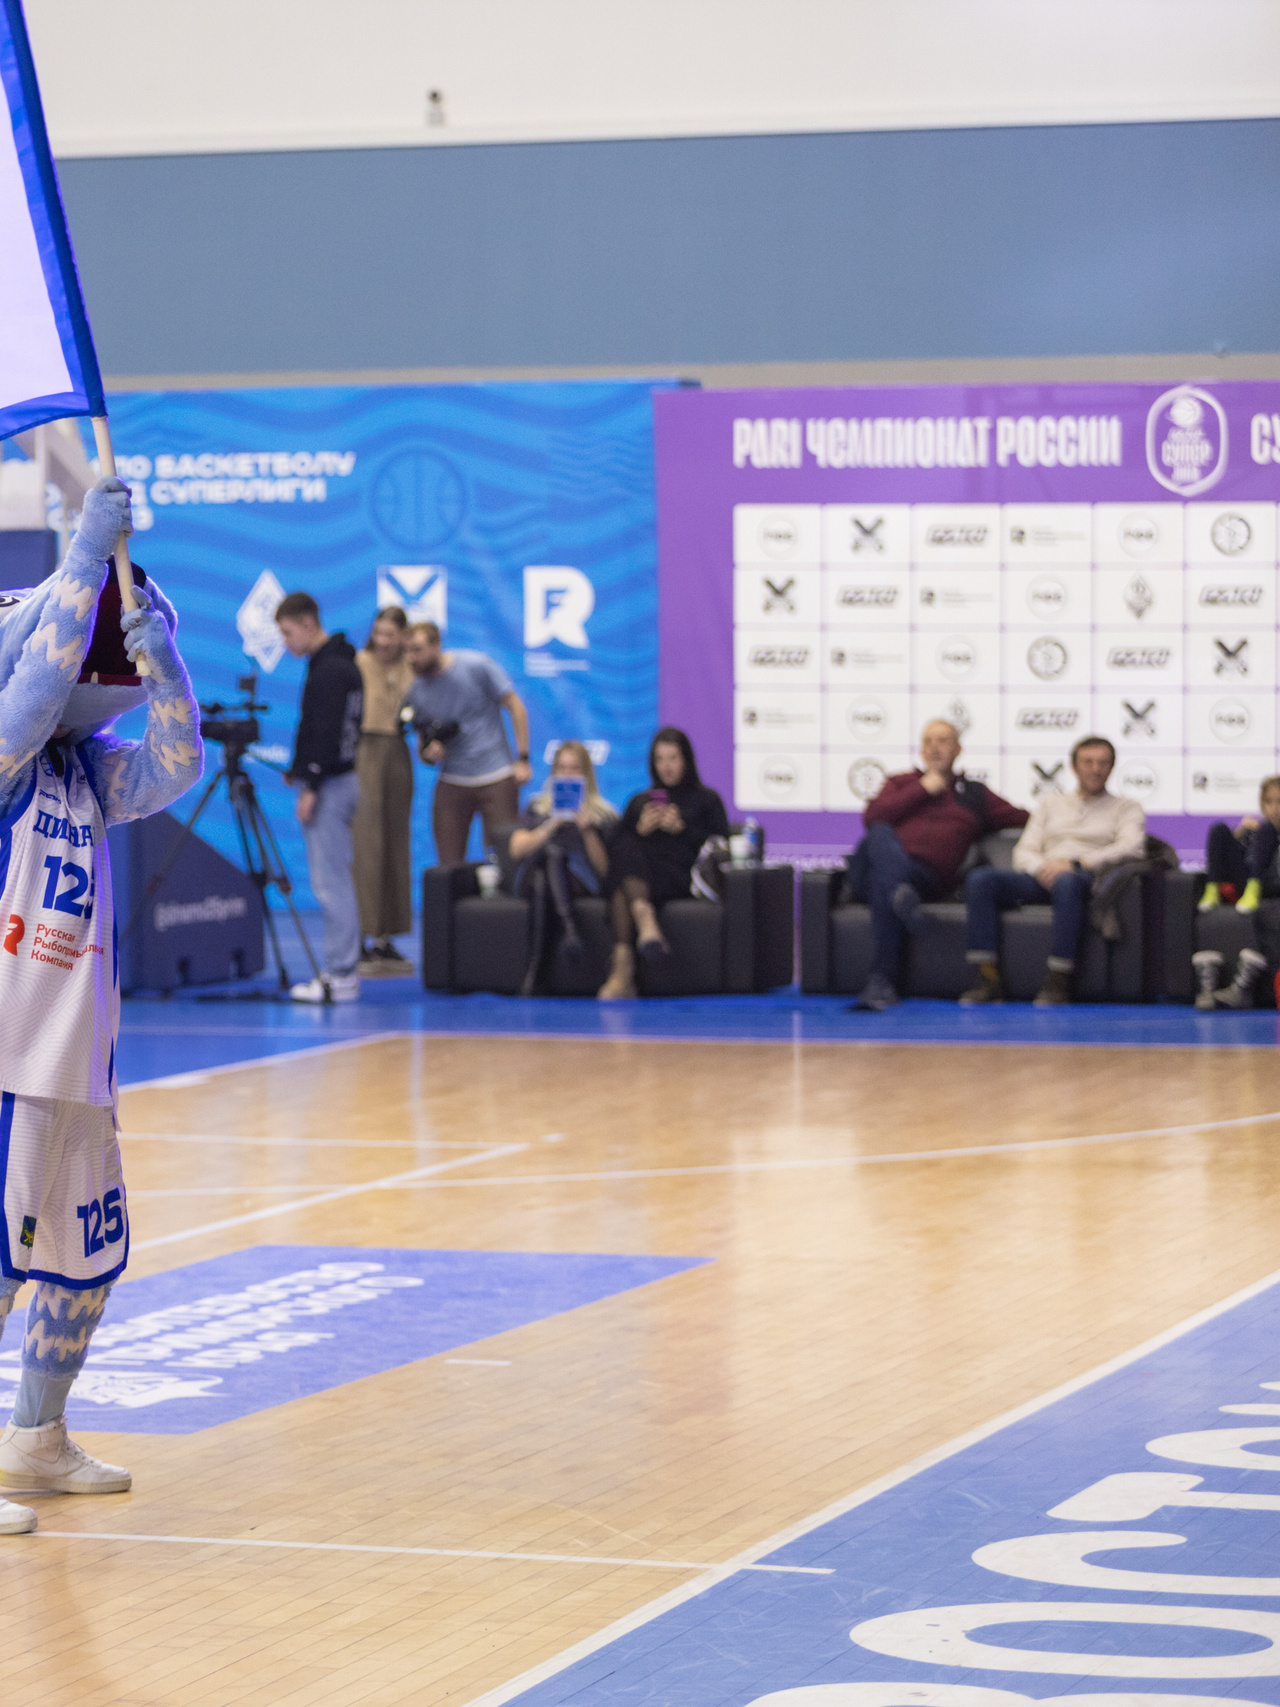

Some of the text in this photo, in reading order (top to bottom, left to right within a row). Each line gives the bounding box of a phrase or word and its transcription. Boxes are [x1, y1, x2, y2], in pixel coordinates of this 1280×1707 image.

[733, 418, 802, 469] PARI
[996, 415, 1121, 468] РОССИИ
[154, 451, 356, 479] БАСКЕТБОЛУ
[150, 478, 328, 505] СУПЕРЛИГИ
[77, 1187, 124, 1258] 125
